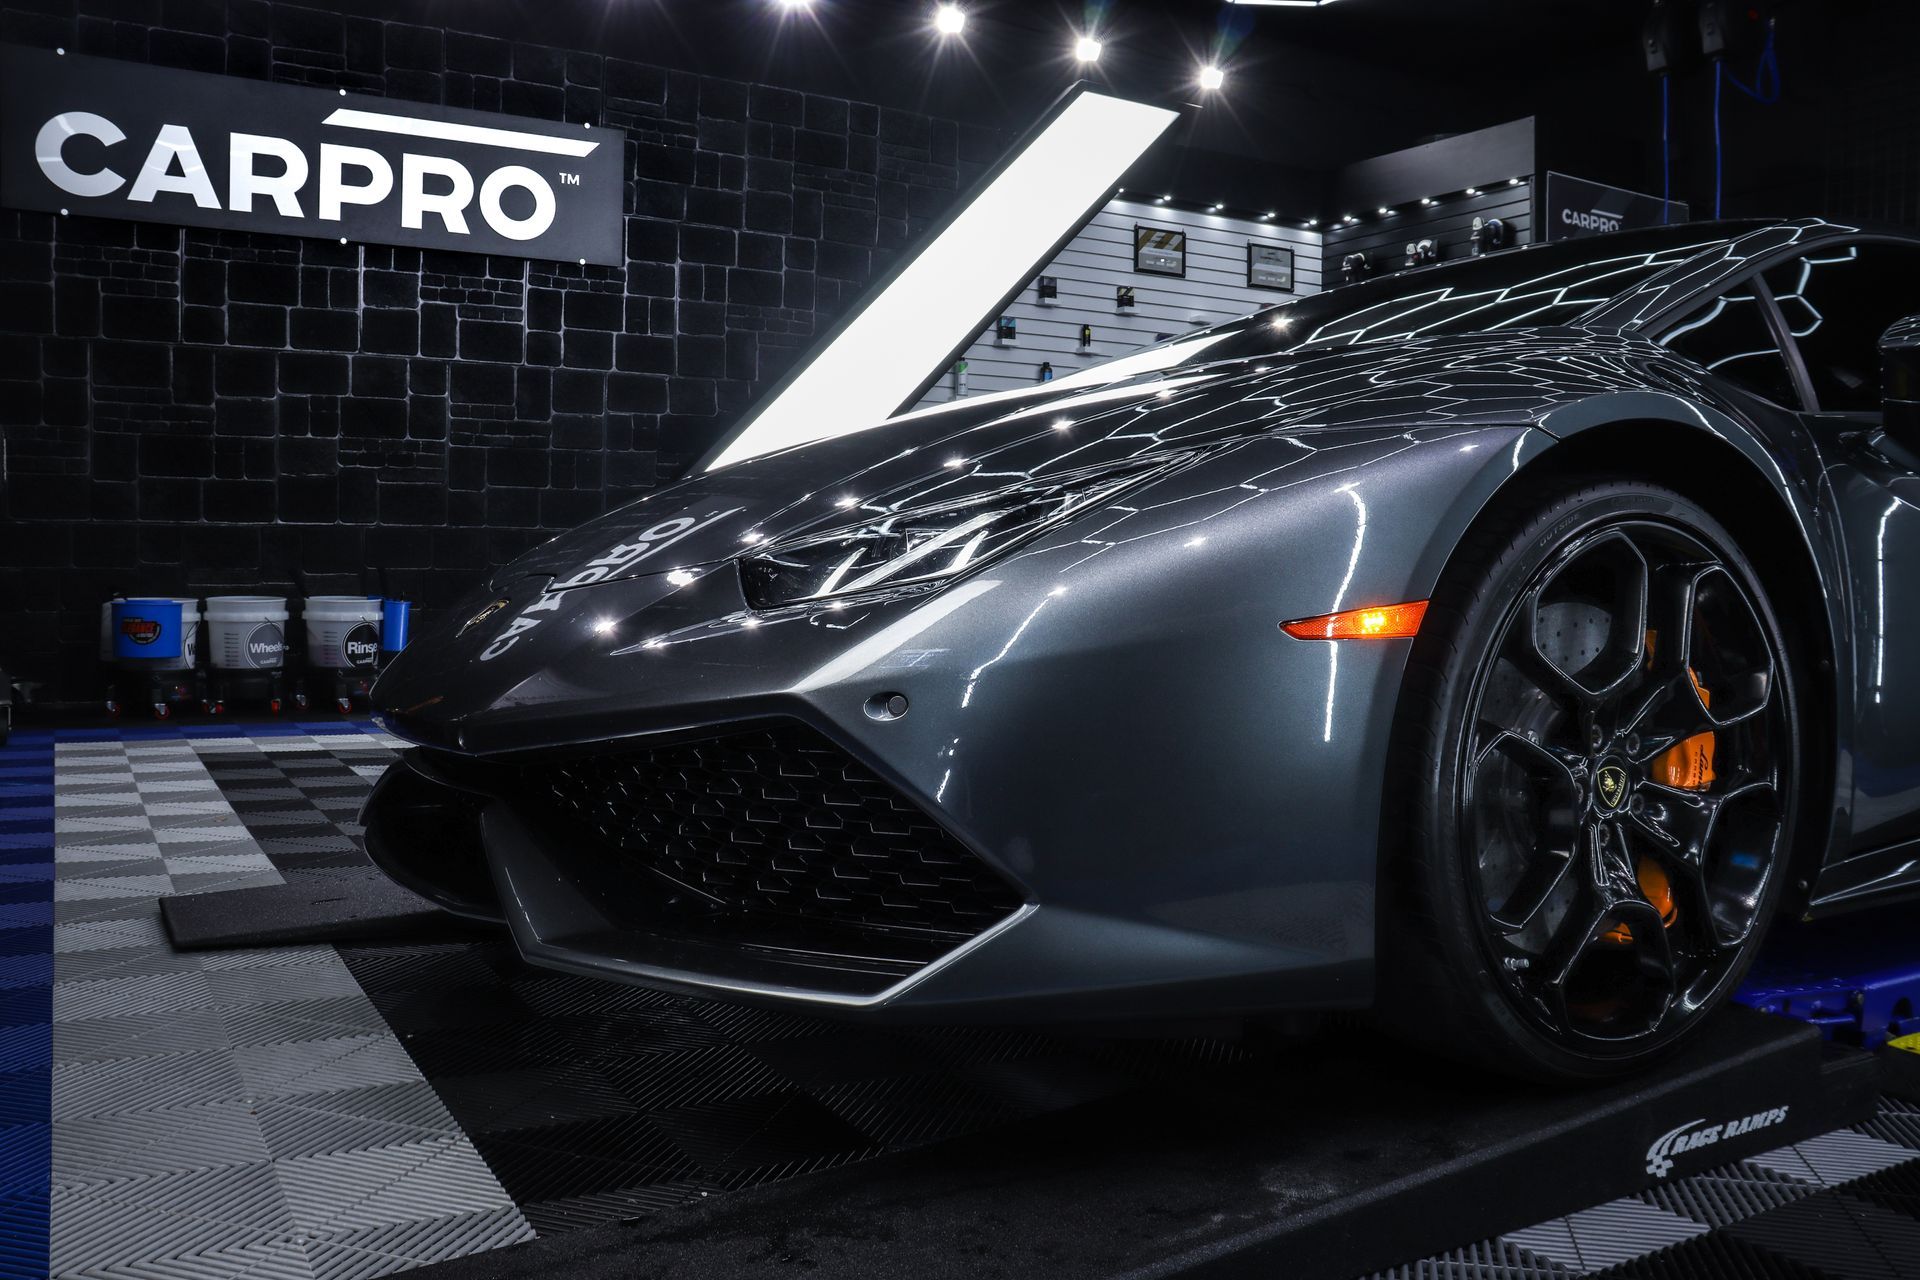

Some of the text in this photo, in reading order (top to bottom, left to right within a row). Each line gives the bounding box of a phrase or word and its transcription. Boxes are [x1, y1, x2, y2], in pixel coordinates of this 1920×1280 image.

[34, 110, 558, 241] CARPRO
[1561, 208, 1620, 233] CARPRO
[347, 641, 378, 655] Rinse
[1722, 1104, 1791, 1139] RAMPS
